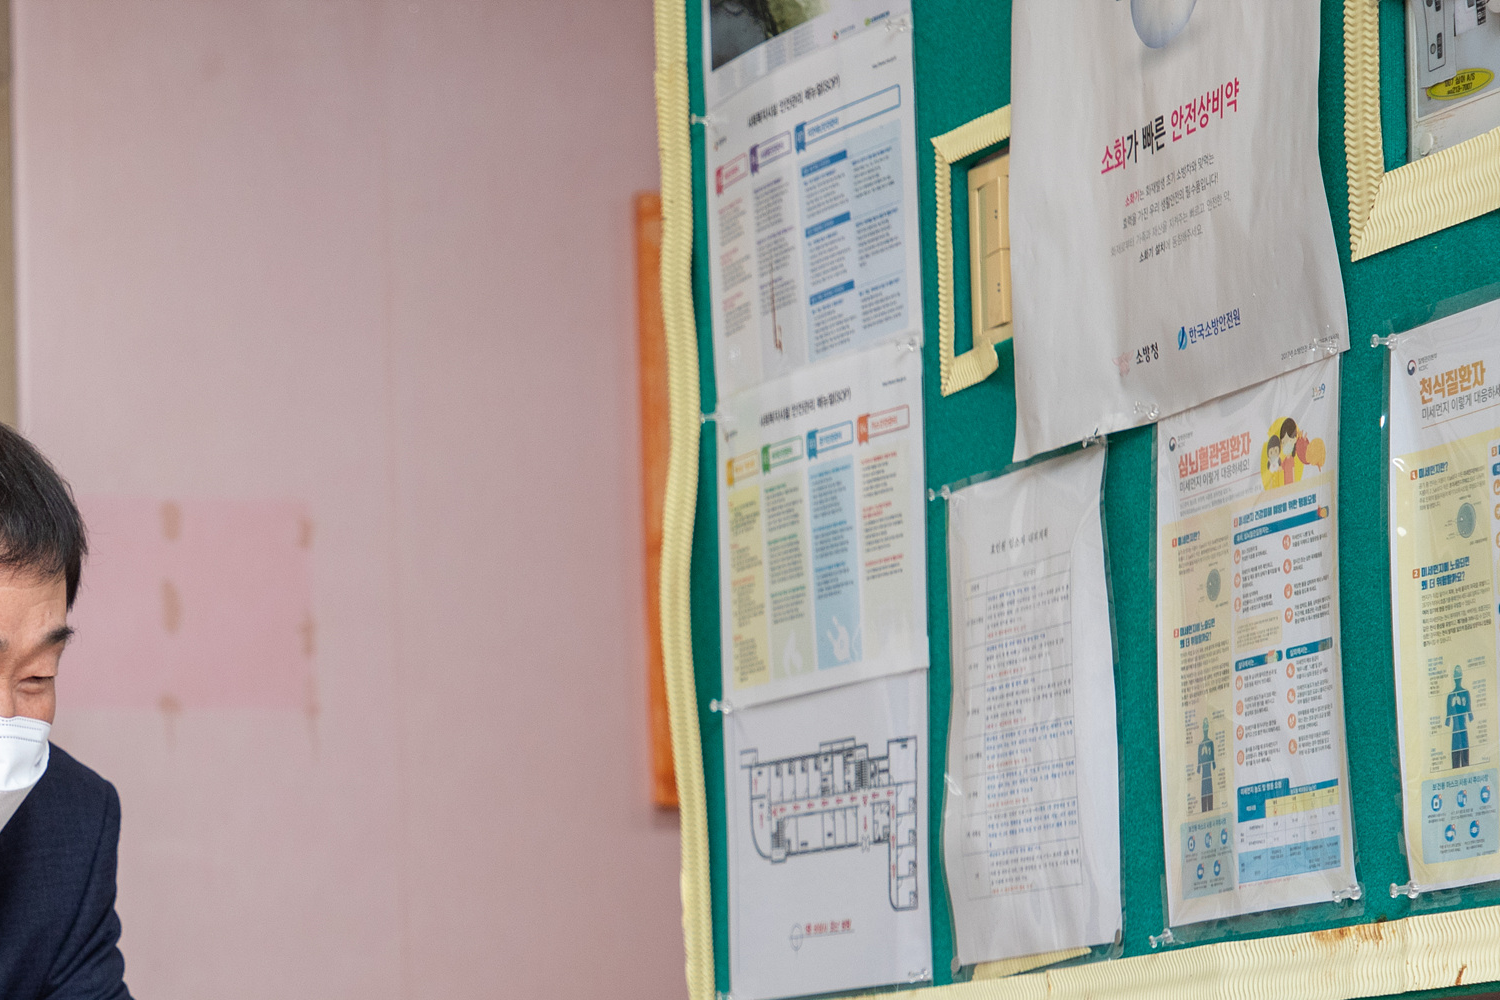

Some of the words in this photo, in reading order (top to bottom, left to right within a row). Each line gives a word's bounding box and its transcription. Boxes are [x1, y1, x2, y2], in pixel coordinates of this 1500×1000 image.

[1101, 129, 1138, 174] 소화가
[1142, 115, 1166, 155] 빠른
[1171, 77, 1239, 142] 안전상비약
[1188, 308, 1241, 344] 한국소방안전원
[1136, 342, 1159, 365] 소방청
[1420, 360, 1486, 405] 천식질환자
[1422, 400, 1450, 420] 미세먼지
[1451, 393, 1472, 410] 이렇게
[1178, 431, 1251, 478] 심뇌혈관질환자
[1179, 475, 1201, 493] 미세먼지
[1202, 469, 1219, 485] 이렇게
[1220, 458, 1249, 478] 대응하세요!
